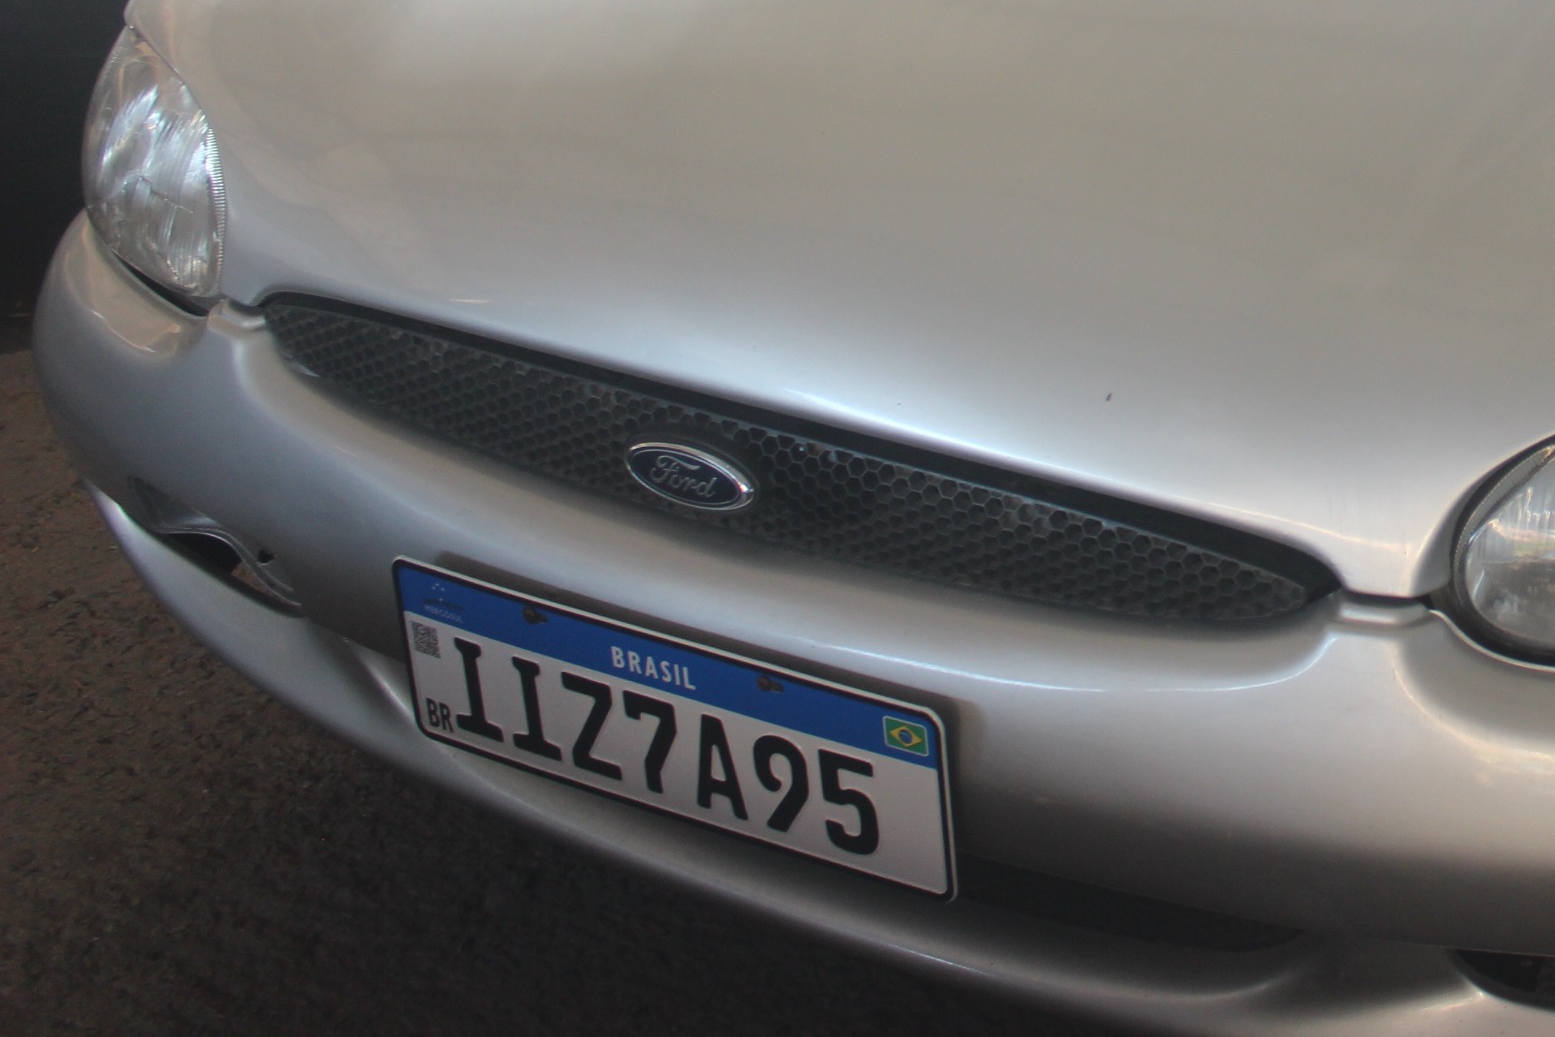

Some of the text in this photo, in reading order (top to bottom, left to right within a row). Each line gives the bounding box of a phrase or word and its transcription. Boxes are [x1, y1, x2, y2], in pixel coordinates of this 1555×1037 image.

[651, 455, 718, 498] Ford
[610, 645, 697, 691] BRASIL
[426, 696, 454, 733] BR
[453, 636, 880, 856] IIZ7A95
